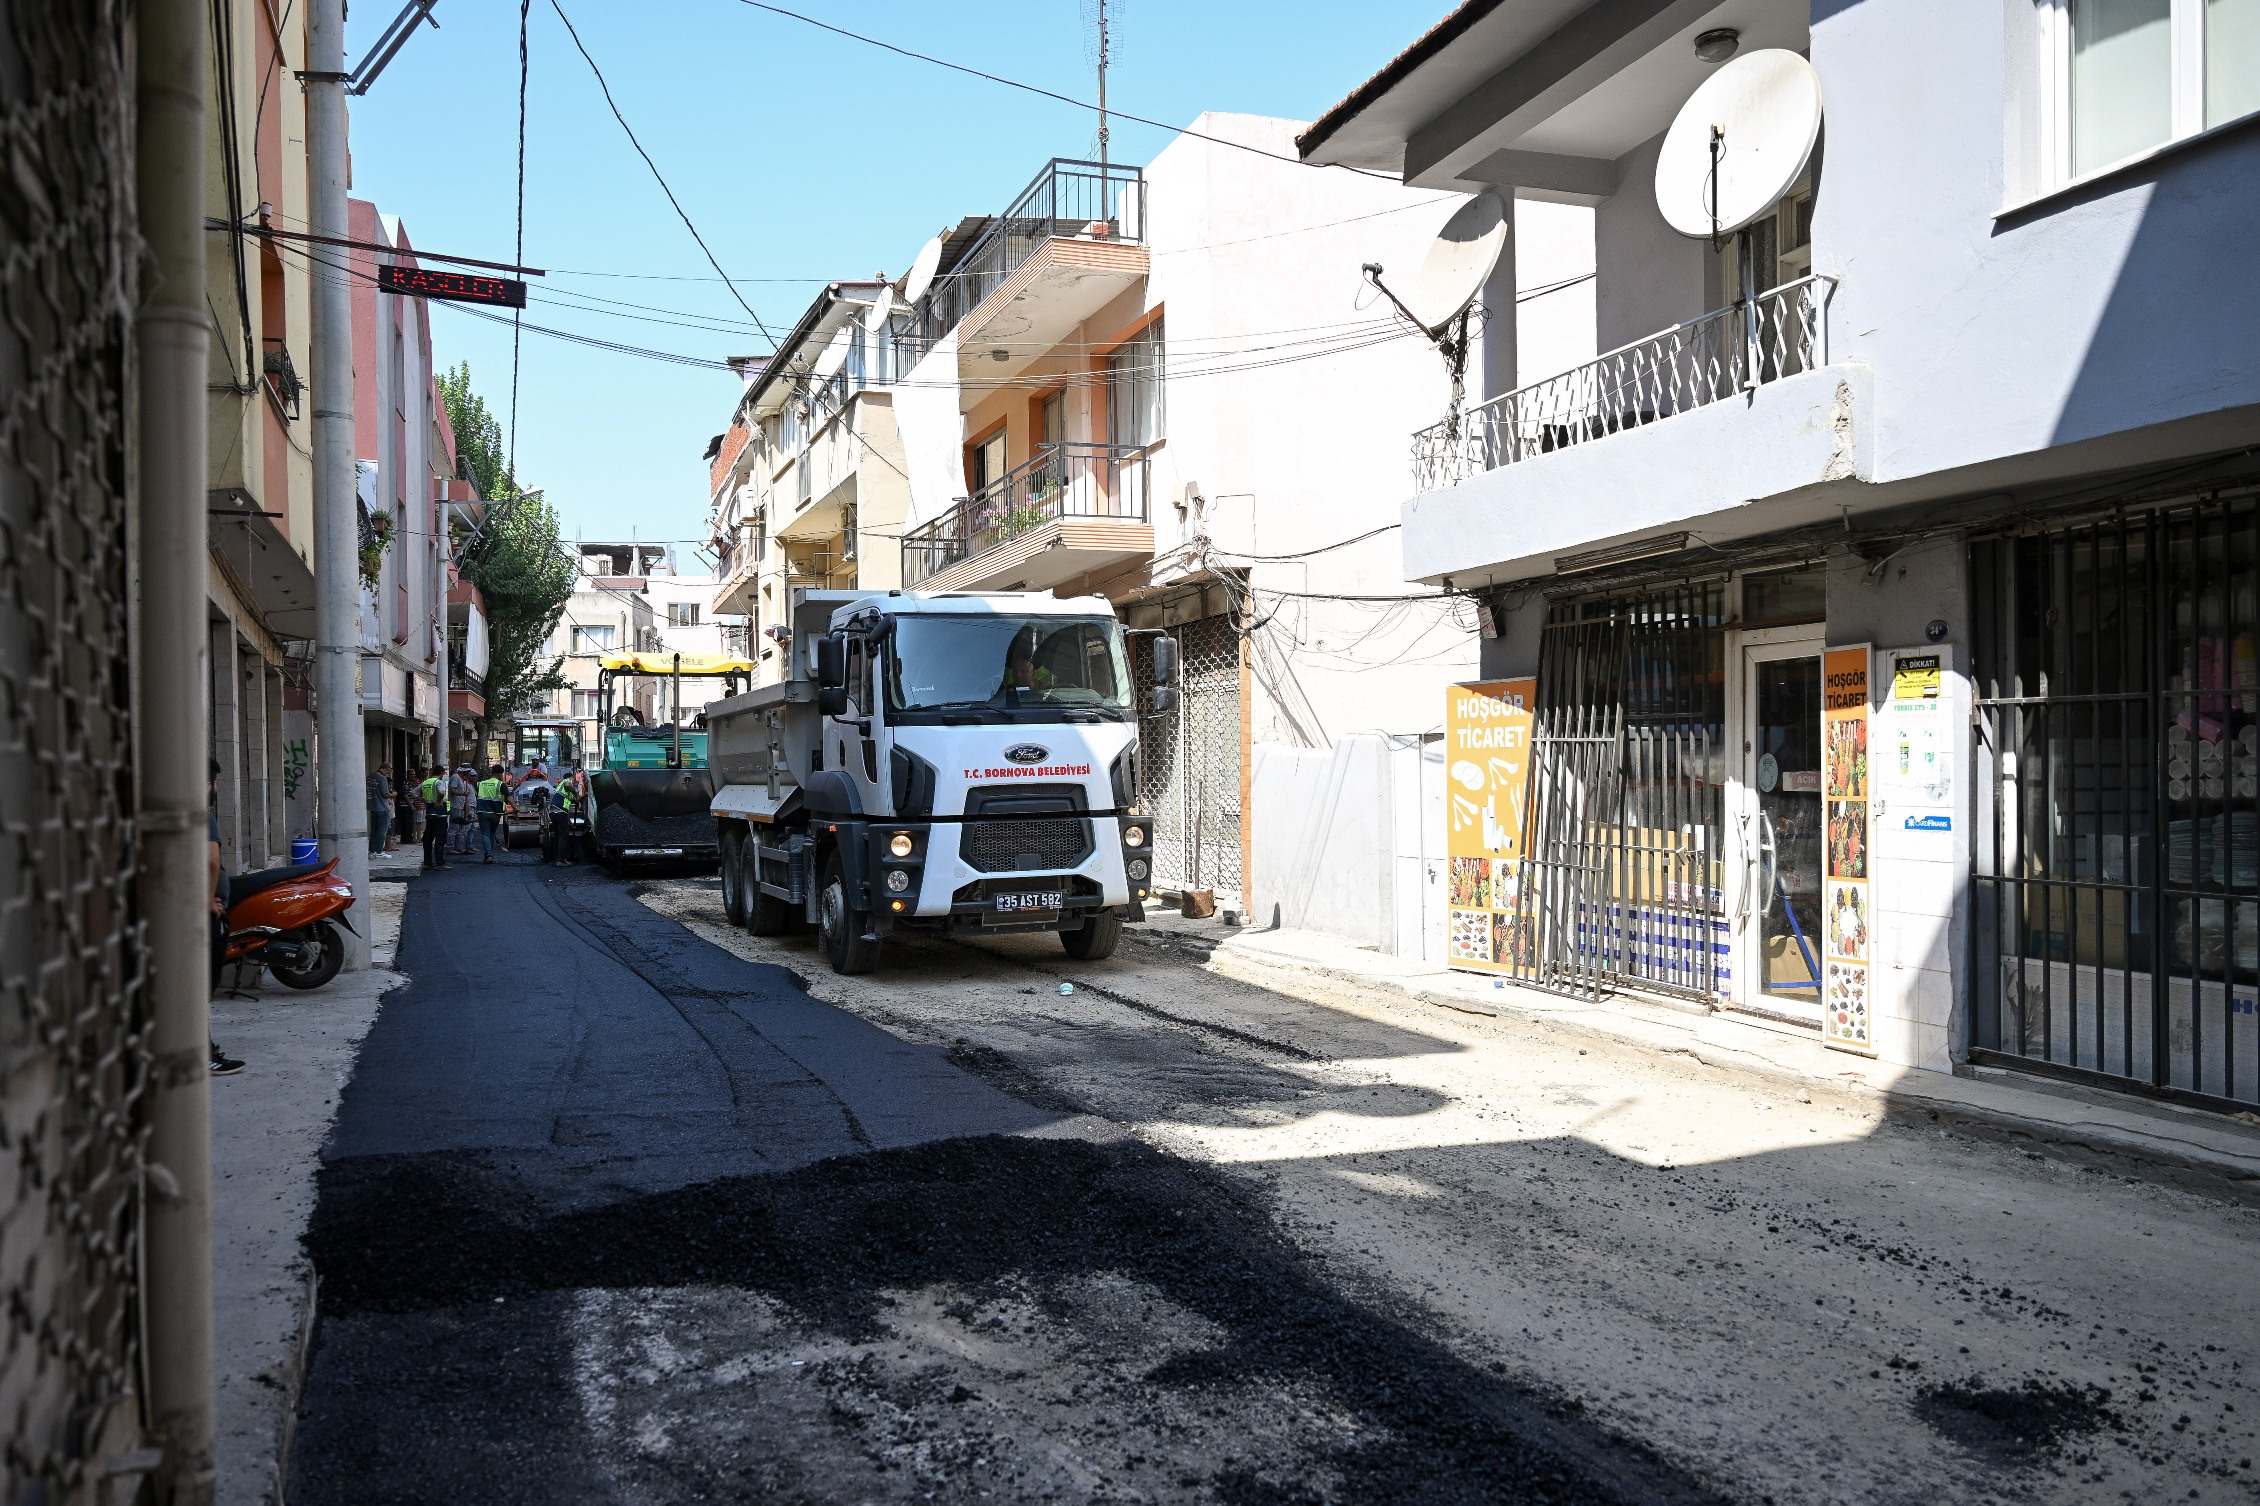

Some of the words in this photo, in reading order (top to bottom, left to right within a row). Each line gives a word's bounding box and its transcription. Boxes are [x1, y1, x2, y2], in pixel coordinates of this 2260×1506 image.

[1909, 659, 1935, 669] DİKKAT!
[1827, 669, 1866, 690] HOŞGÖR
[1457, 690, 1525, 723] HOŞGÖR
[1827, 691, 1867, 708] TİCARET
[1457, 722, 1526, 749] TİCARET
[1015, 748, 1040, 760] Ford
[963, 769, 983, 779] T.C.
[985, 767, 1036, 778] BORNOVA
[1037, 763, 1091, 777] BELEDİYESİ
[1004, 895, 1018, 908] 35
[1020, 894, 1039, 907] AST
[1041, 893, 1061, 905] 582
